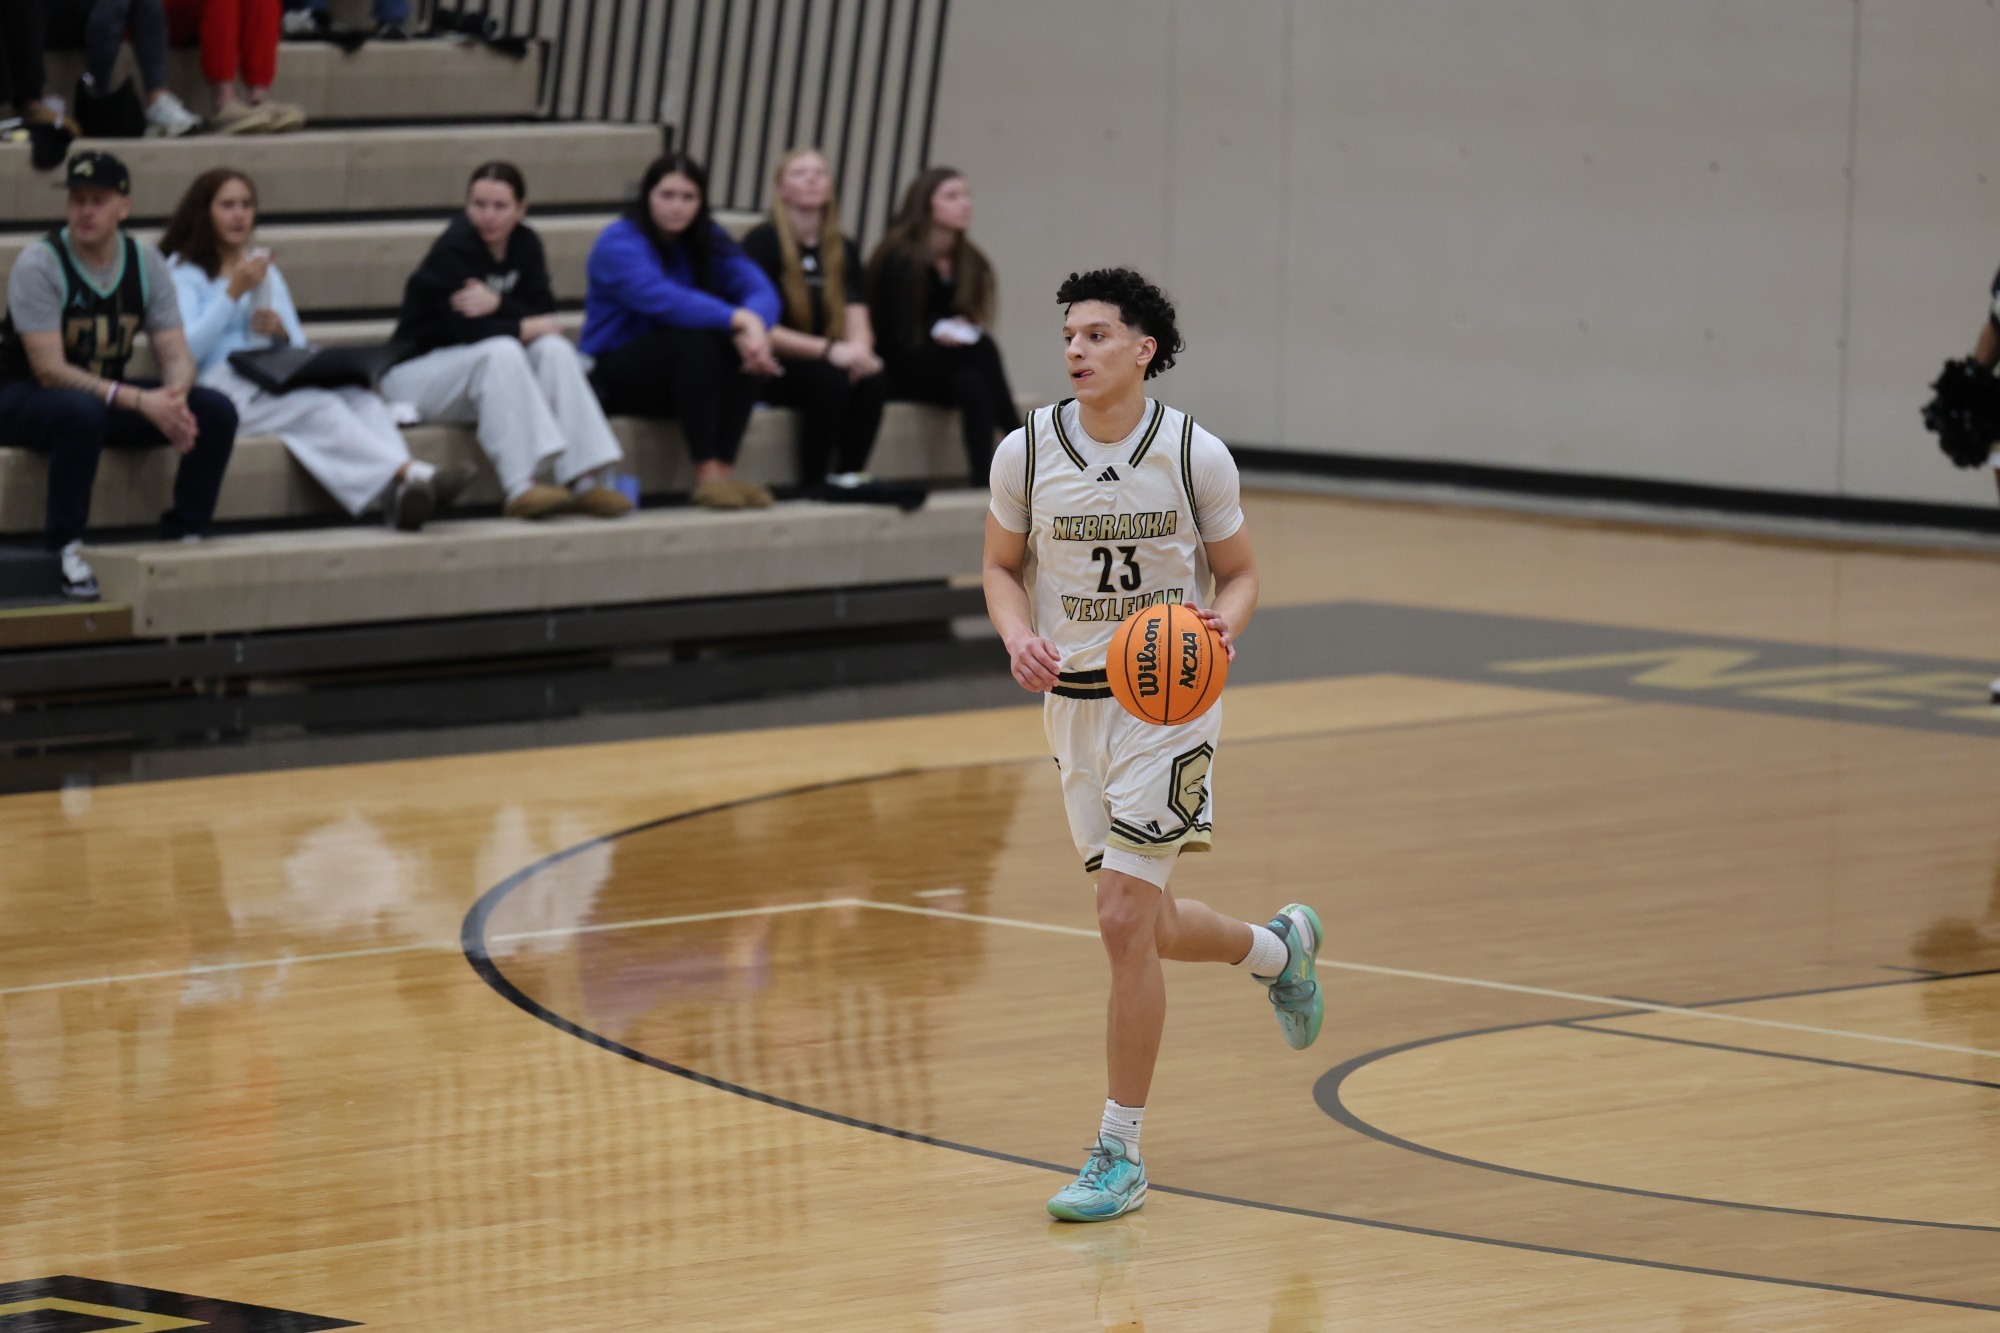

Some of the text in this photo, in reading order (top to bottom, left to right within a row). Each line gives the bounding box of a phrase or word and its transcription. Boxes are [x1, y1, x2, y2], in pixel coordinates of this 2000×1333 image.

[1053, 510, 1177, 541] NEBRASKA
[1091, 545, 1142, 593] 23
[1136, 617, 1162, 698] Wilson
[1178, 632, 1198, 690] NCAA
